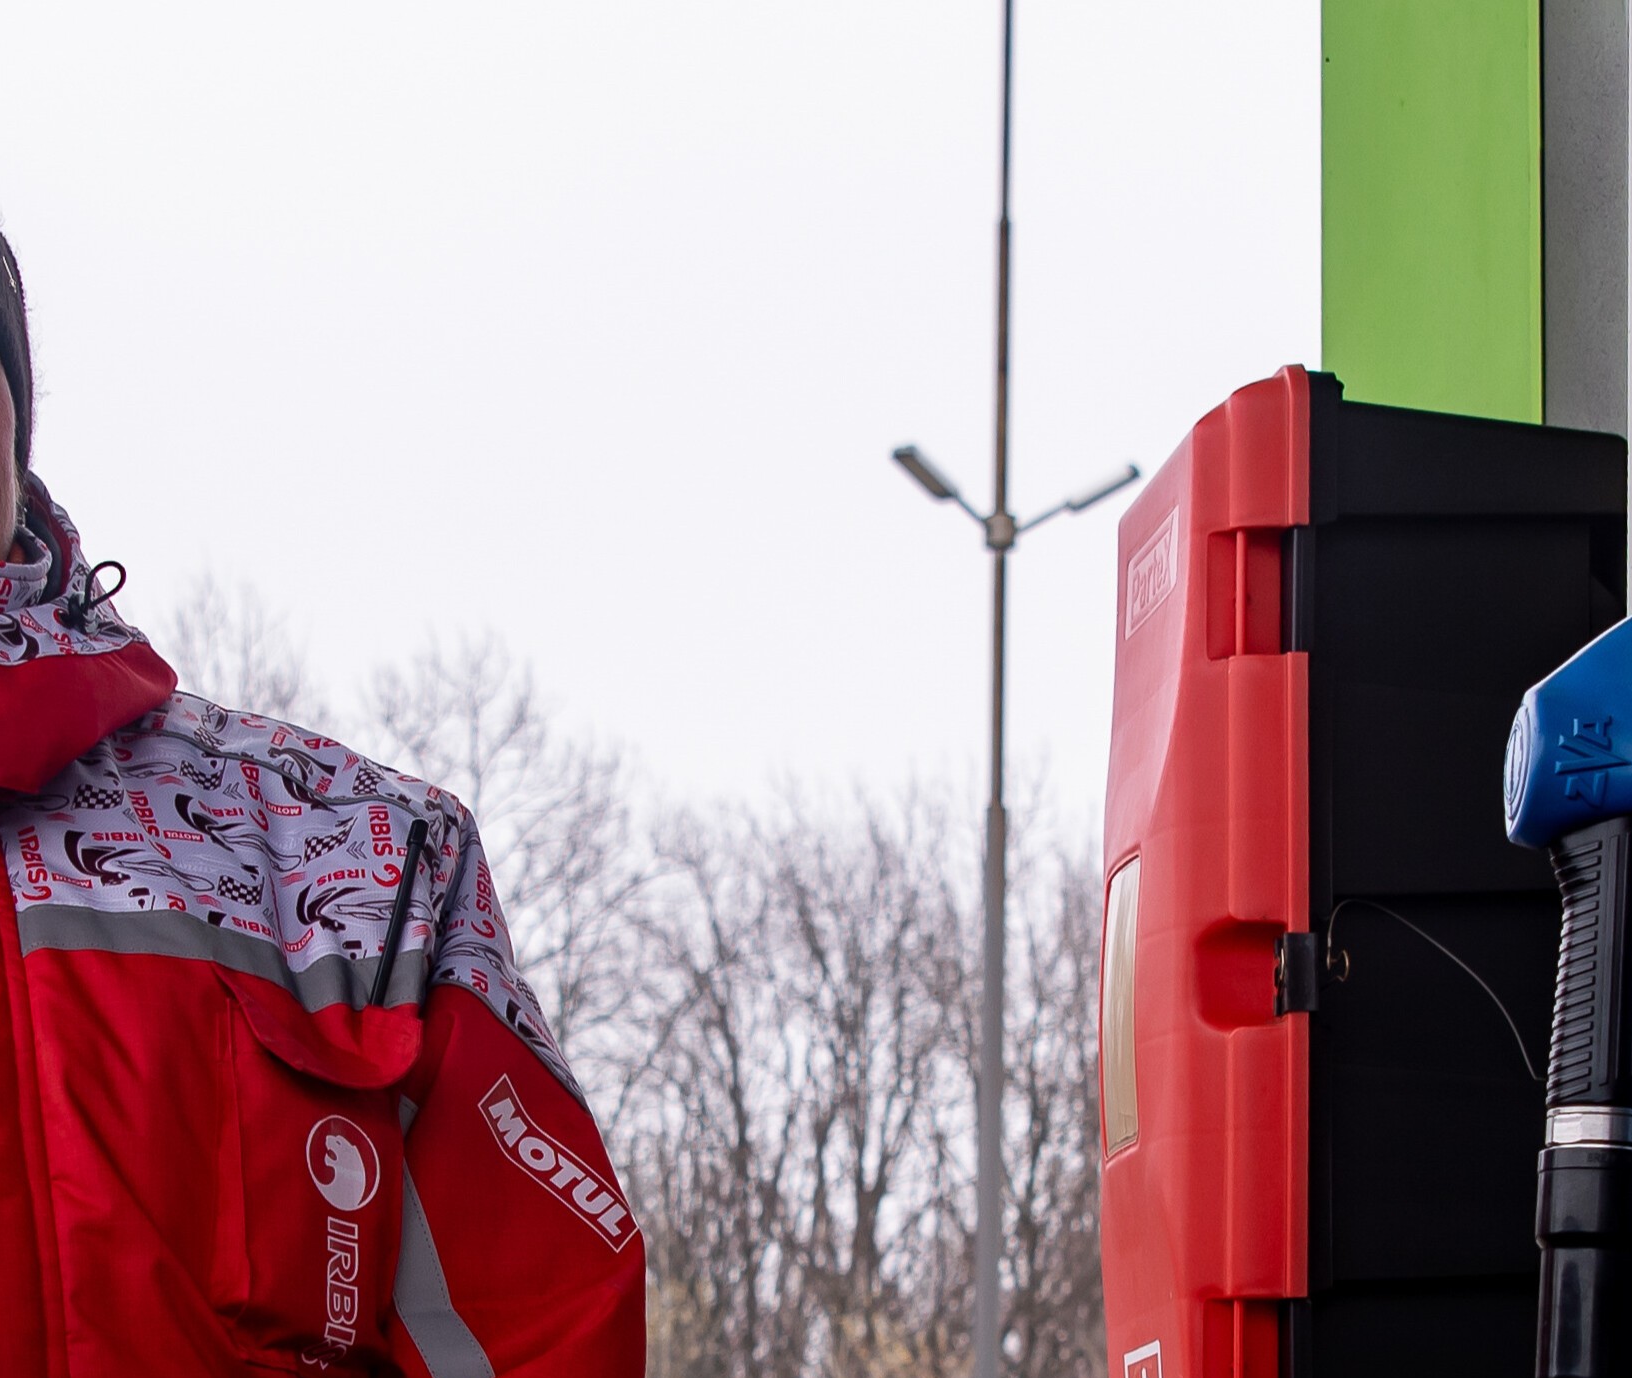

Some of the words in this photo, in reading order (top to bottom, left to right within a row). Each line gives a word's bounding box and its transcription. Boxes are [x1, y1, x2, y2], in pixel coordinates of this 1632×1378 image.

[126, 790, 160, 838] IRBIS
[368, 805, 394, 857] IRBIS
[92, 832, 144, 843] IRBIS
[163, 830, 204, 843] MOTUL
[18, 826, 49, 884] IRBIS
[52, 872, 93, 889] MOTUL
[317, 868, 365, 887] IRBIS
[474, 859, 493, 913] IRBIS
[231, 916, 276, 940] IRBIS
[489, 1097, 629, 1238] MOTUL
